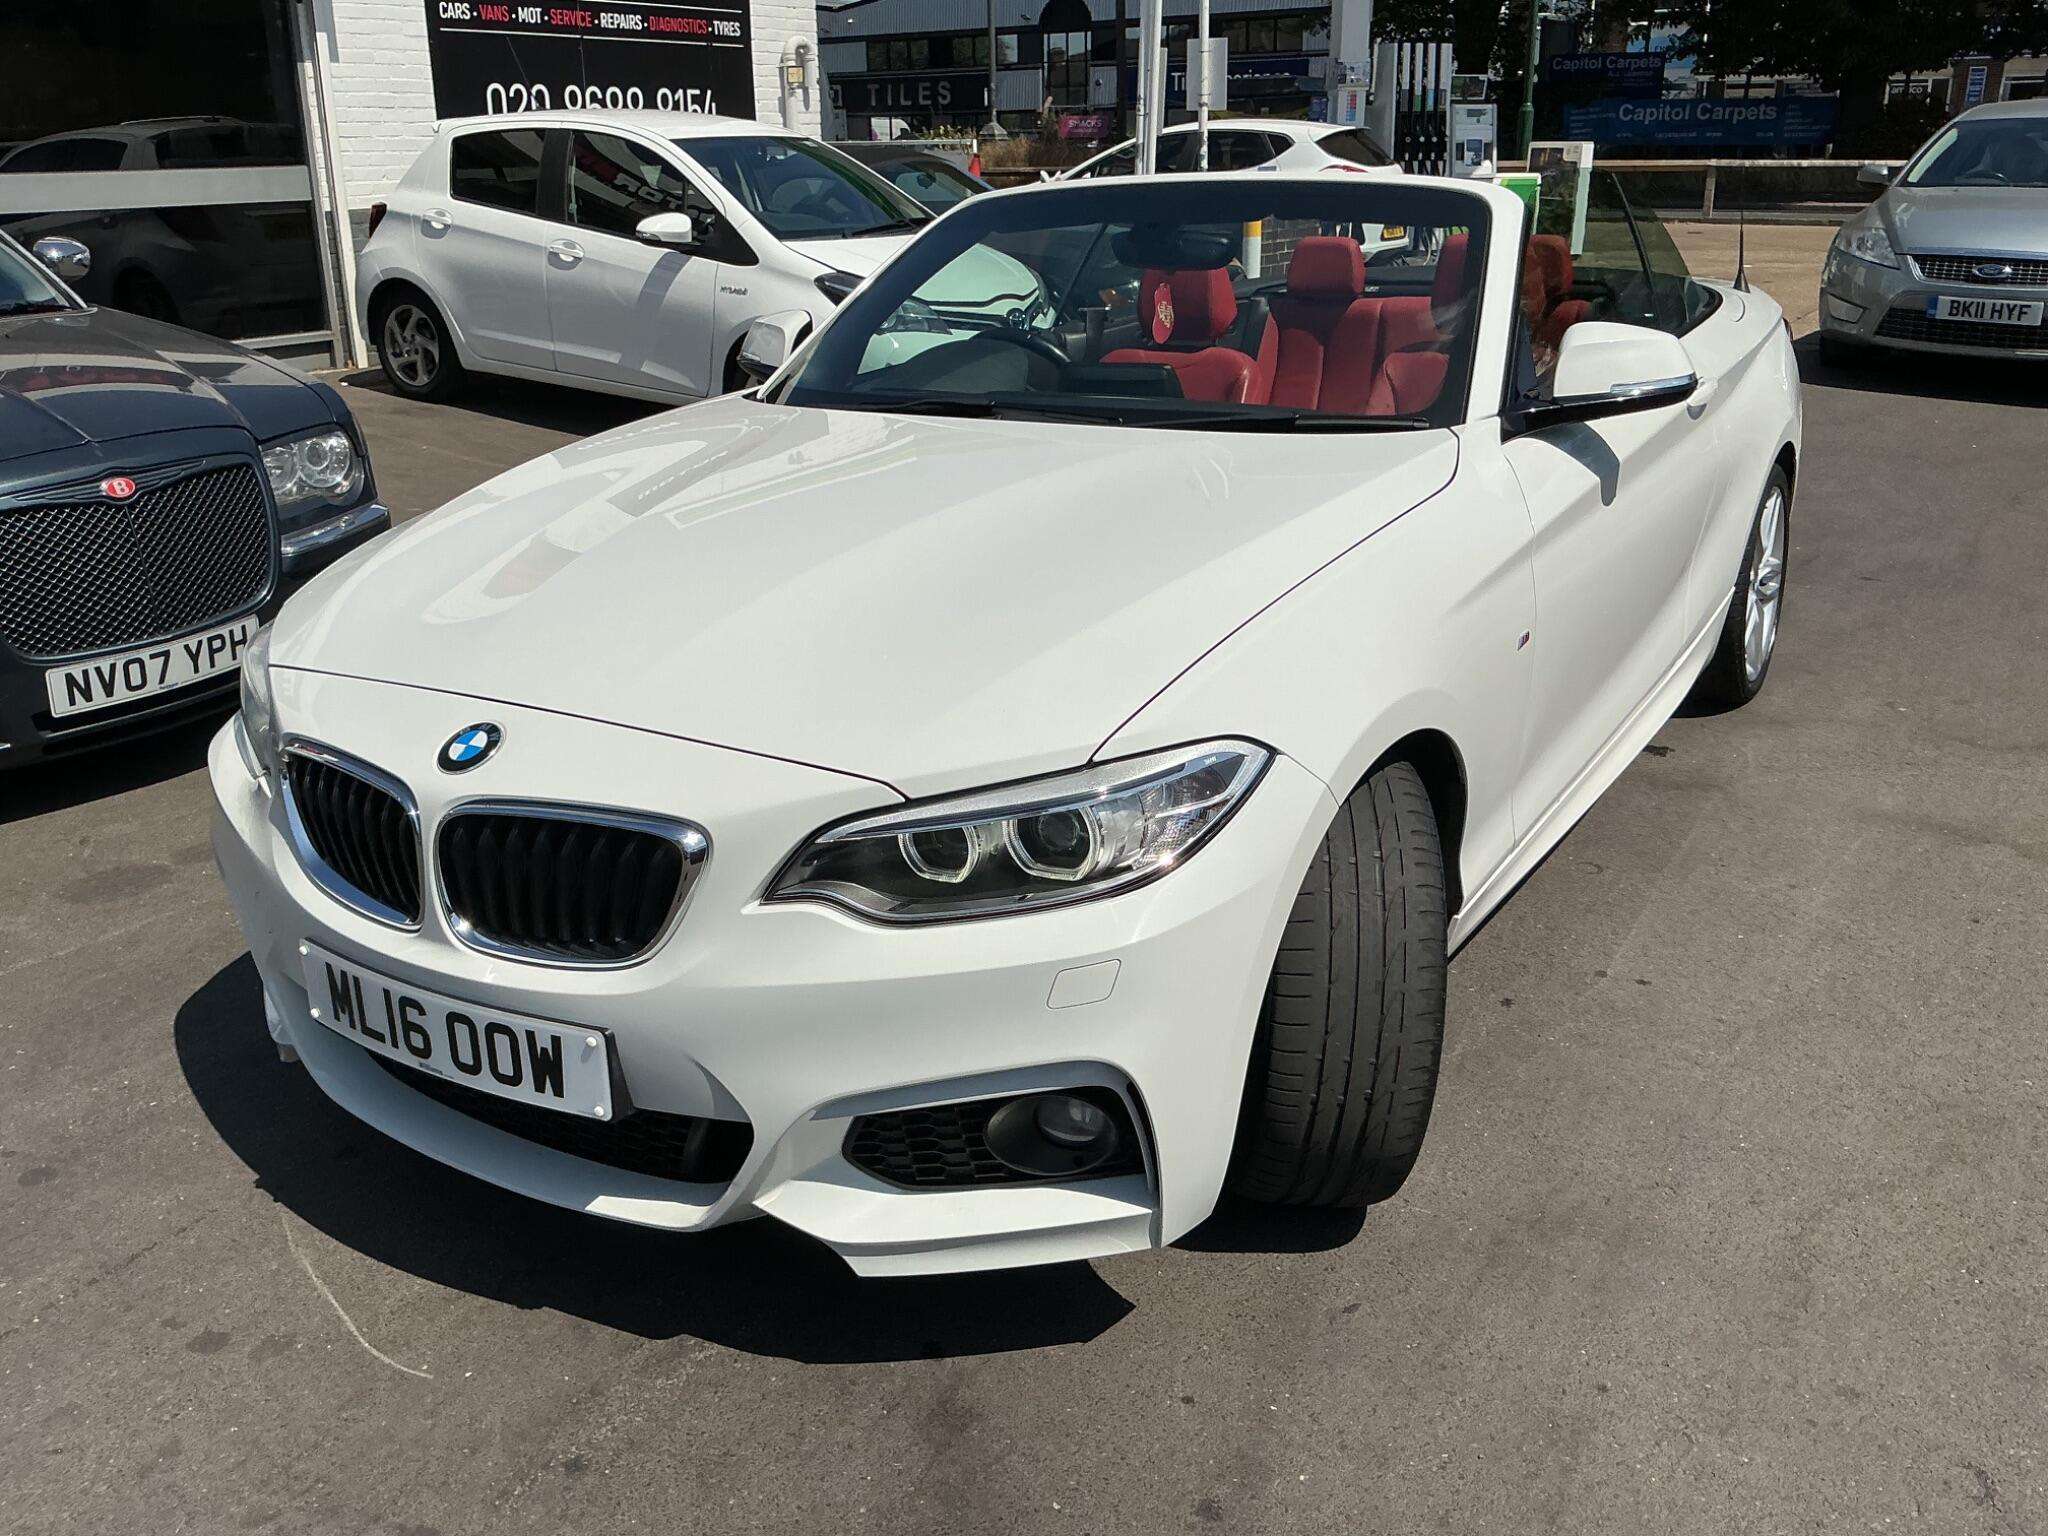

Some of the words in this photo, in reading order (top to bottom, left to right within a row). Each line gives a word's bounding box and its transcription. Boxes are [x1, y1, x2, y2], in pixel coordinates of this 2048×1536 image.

[439, 1, 471, 20] CARS
[478, 4, 510, 22] VANS
[517, 6, 542, 24] MOT
[550, 8, 593, 27] SERVICE
[600, 12, 643, 31] REPAIRS
[649, 16, 708, 34] DIAGNOSTICS
[713, 20, 741, 37] TYRES
[1552, 56, 1602, 72] Capitol
[1606, 55, 1663, 72] Carpets
[866, 80, 953, 107] TILES
[1618, 103, 1691, 125] Capitol
[1697, 102, 1777, 125] Carpets
[1990, 303, 2032, 322] HYF
[64, 651, 172, 707] NV07
[183, 624, 249, 675] YPH
[325, 962, 433, 1060] ML16
